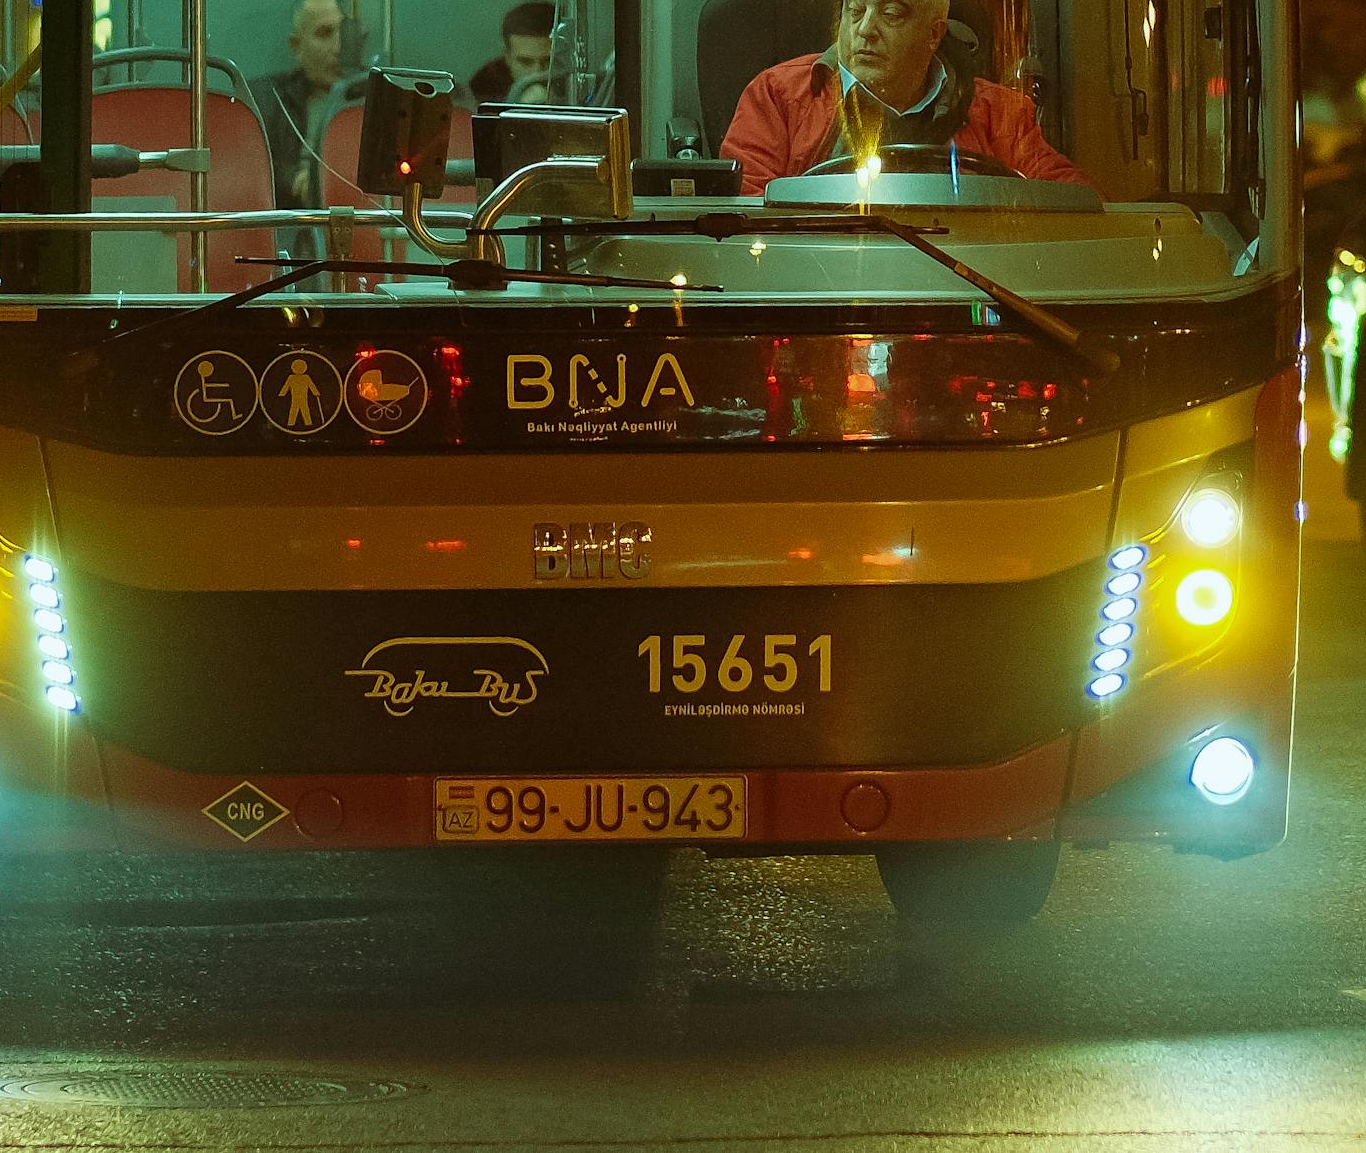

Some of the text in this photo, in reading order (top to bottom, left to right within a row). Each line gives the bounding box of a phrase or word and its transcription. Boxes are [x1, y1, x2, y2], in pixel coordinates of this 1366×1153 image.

[506, 352, 696, 409] BNA
[620, 419, 677, 433] Agentliyi
[533, 521, 652, 580] BMC
[637, 634, 832, 693] 15651
[344, 670, 449, 704] Baku
[752, 701, 805, 715] NÖMRƏSİ
[227, 802, 265, 821] CNG
[447, 811, 474, 829] AZ
[484, 783, 735, 834] 99-JU-943
